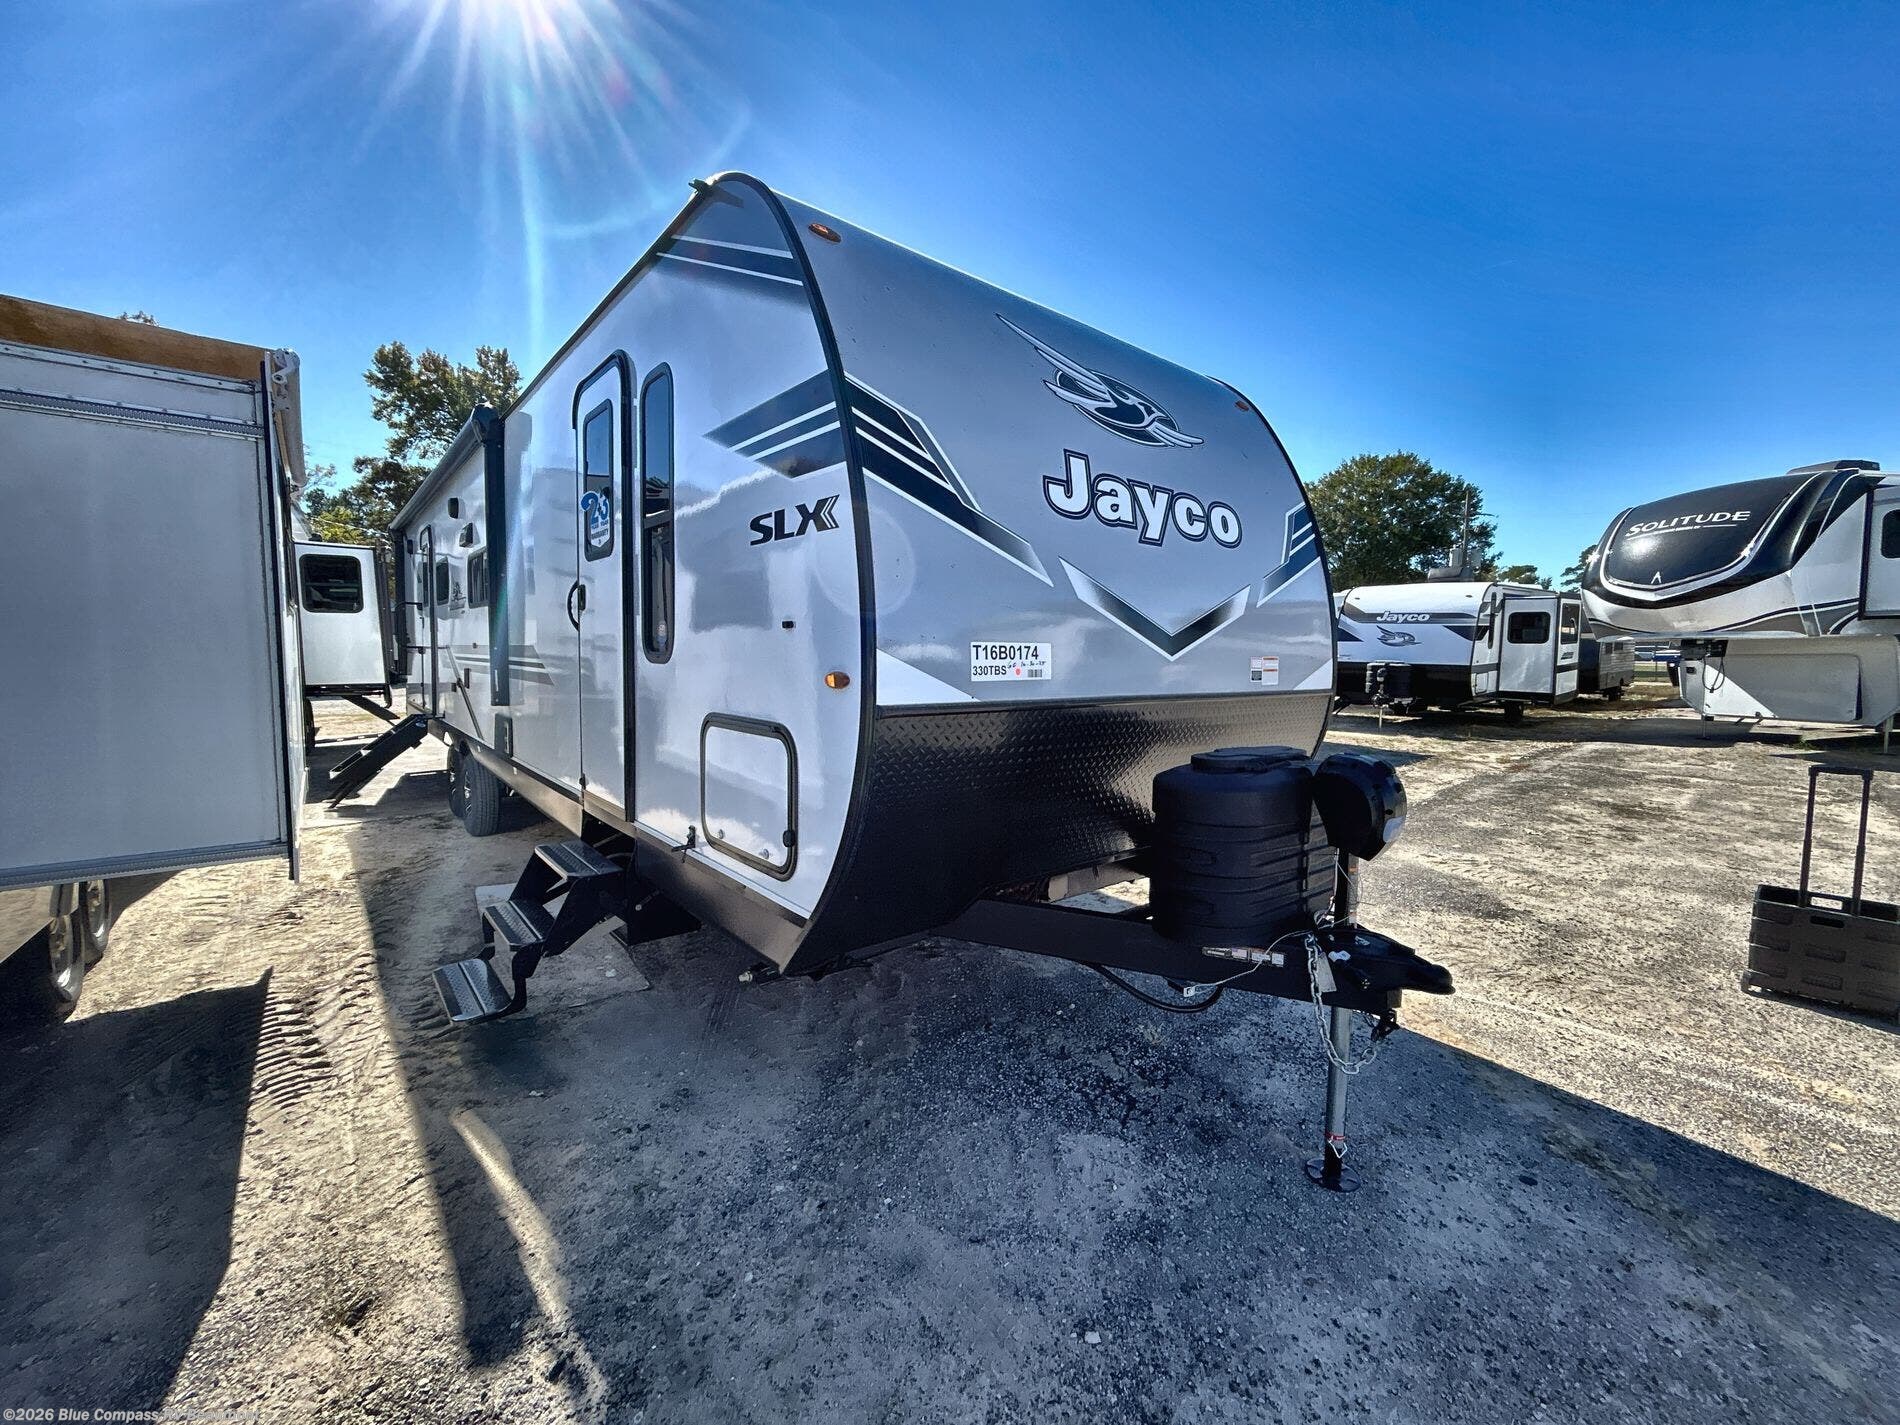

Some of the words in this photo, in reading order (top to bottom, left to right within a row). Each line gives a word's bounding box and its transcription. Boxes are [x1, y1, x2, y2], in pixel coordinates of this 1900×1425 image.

[1042, 448, 1243, 549] Jayco
[749, 494, 840, 546] SLX
[1625, 510, 1751, 537] SOLITUDE
[1376, 610, 1431, 624] Jayco
[972, 645, 1039, 660] T16B0174
[972, 665, 1007, 676] 330TBS
